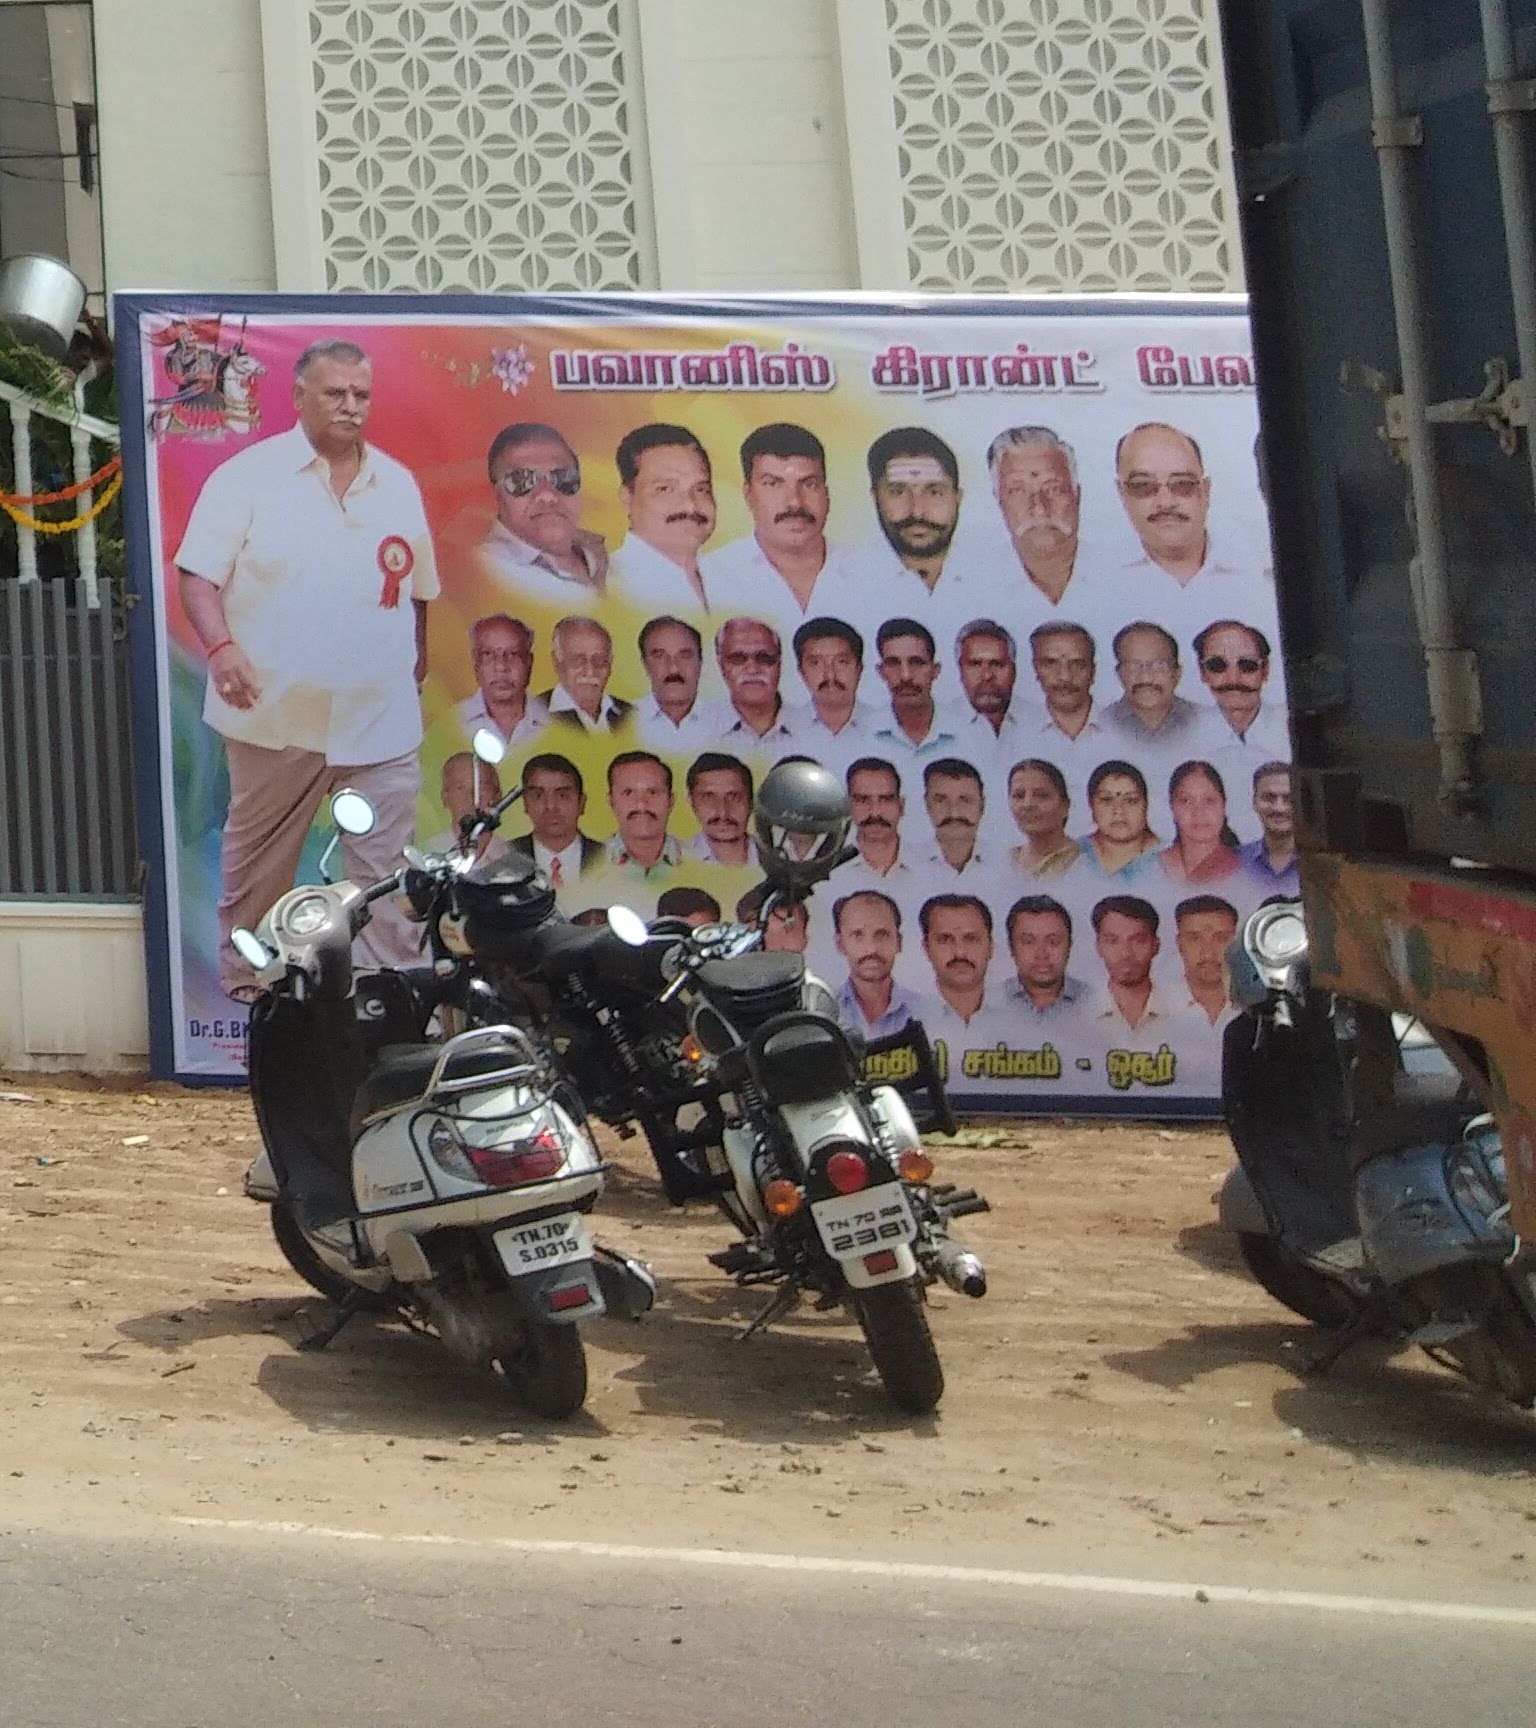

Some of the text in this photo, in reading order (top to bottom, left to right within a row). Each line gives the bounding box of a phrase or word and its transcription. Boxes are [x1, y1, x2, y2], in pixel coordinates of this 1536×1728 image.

[552, 341, 833, 388] பவானிஸ்
[515, 1222, 565, 1246] TN.70
[831, 1218, 910, 1251] 2381
